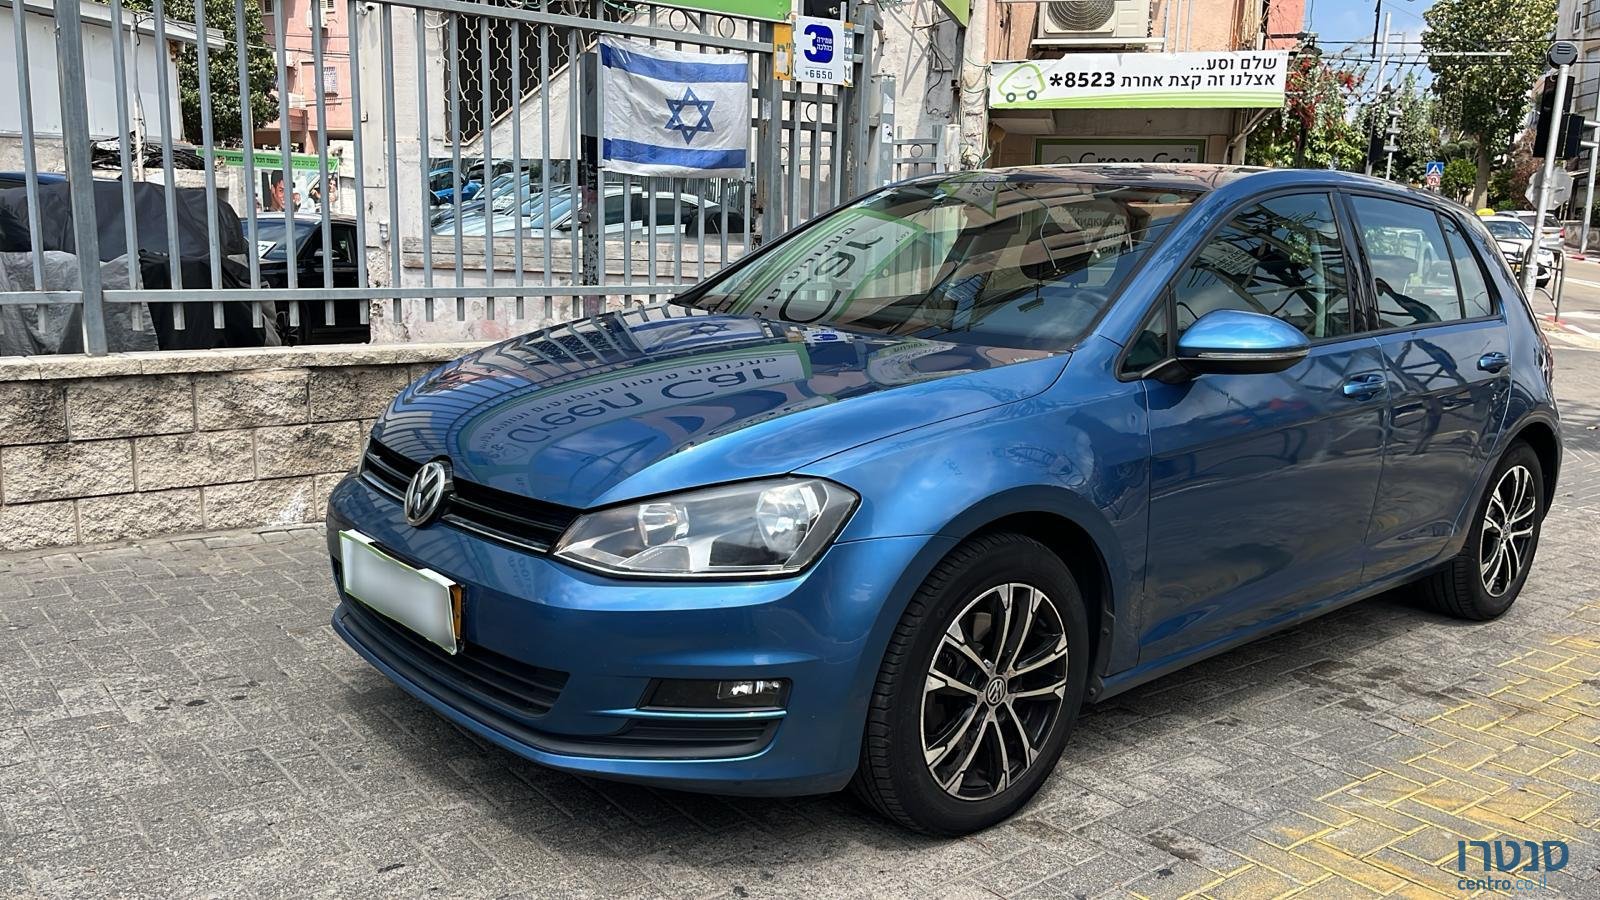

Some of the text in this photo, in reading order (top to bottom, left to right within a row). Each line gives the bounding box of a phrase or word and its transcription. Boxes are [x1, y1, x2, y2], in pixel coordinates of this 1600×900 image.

[1190, 55, 1277, 71] שלם וסע...
[1120, 75, 1163, 87] אחרת
[1168, 75, 1201, 90] קצת
[1207, 74, 1225, 87] זה
[1230, 71, 1276, 86] אצלנו
